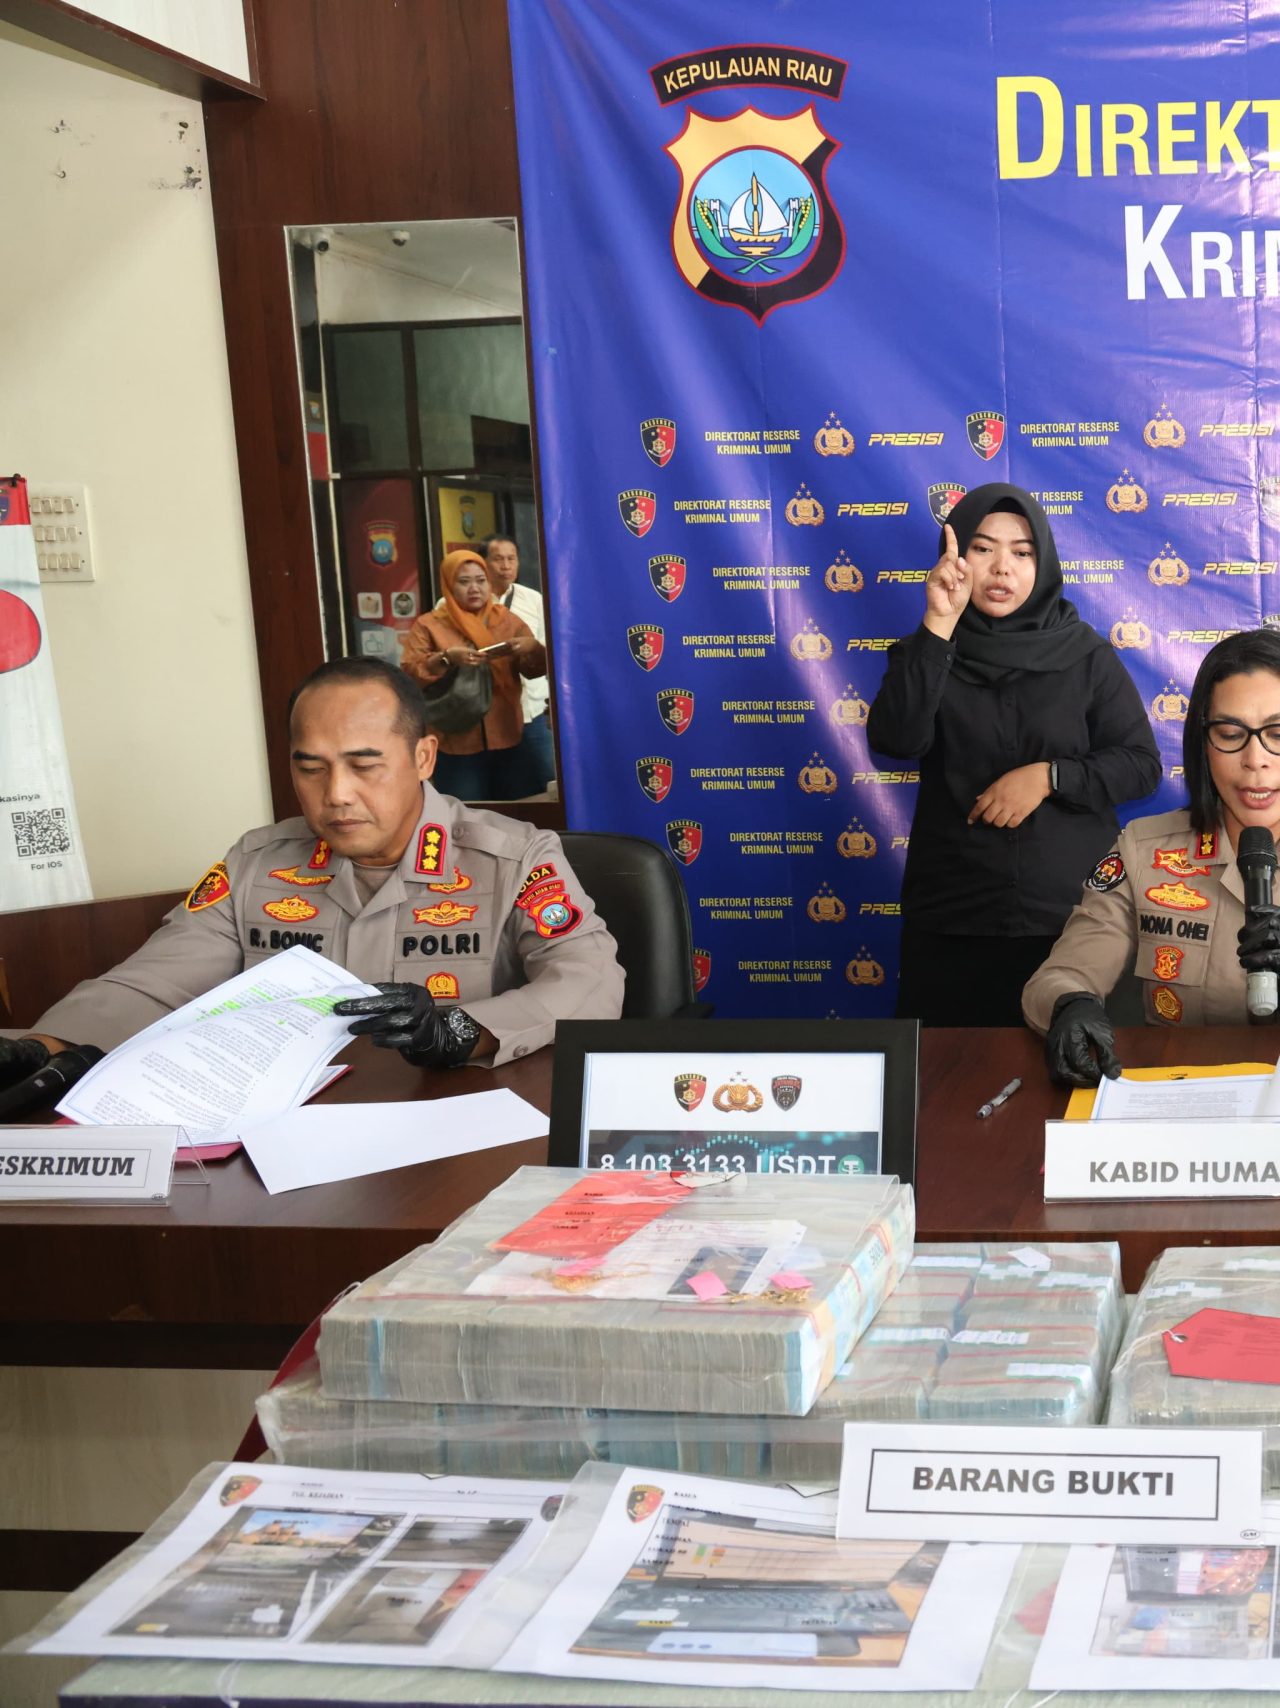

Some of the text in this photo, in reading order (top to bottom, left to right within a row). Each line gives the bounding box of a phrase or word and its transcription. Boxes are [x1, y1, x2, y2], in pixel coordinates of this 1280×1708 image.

[663, 56, 833, 94] KEPULAUAN RIAU
[1020, 421, 1120, 434] DIREKTORAT RESERSE
[704, 429, 800, 442] DIREKTORAT RESERSE
[868, 433, 945, 446] PRESISI
[1031, 435, 1110, 447] KRIMINAL UMUM
[715, 443, 793, 455] KRIMINAL UMUM
[674, 499, 770, 511] DIREKTORAT RESERSE
[1162, 491, 1238, 507] PRESISI
[836, 501, 910, 517] PRESISI
[684, 512, 761, 524] KRIMINAL UMUM
[1203, 561, 1278, 575] PRESISI
[682, 634, 776, 645] DIREKTORAT RESERSE
[693, 647, 766, 658] KRIMINAL UMUM
[722, 700, 815, 711] DIREKTORAT RESERSE
[733, 713, 805, 724] KRIMINAL UMUM
[730, 831, 823, 842] DIREKTORAT RESERSE
[740, 843, 815, 855] KRIMINAL UMUM
[1139, 914, 1174, 936] NONA
[402, 931, 481, 958] POLRI
[756, 1155, 836, 1175] USDT
[1089, 1161, 1179, 1183] KABID
[911, 1466, 1175, 1496] BARANG BUKTI
